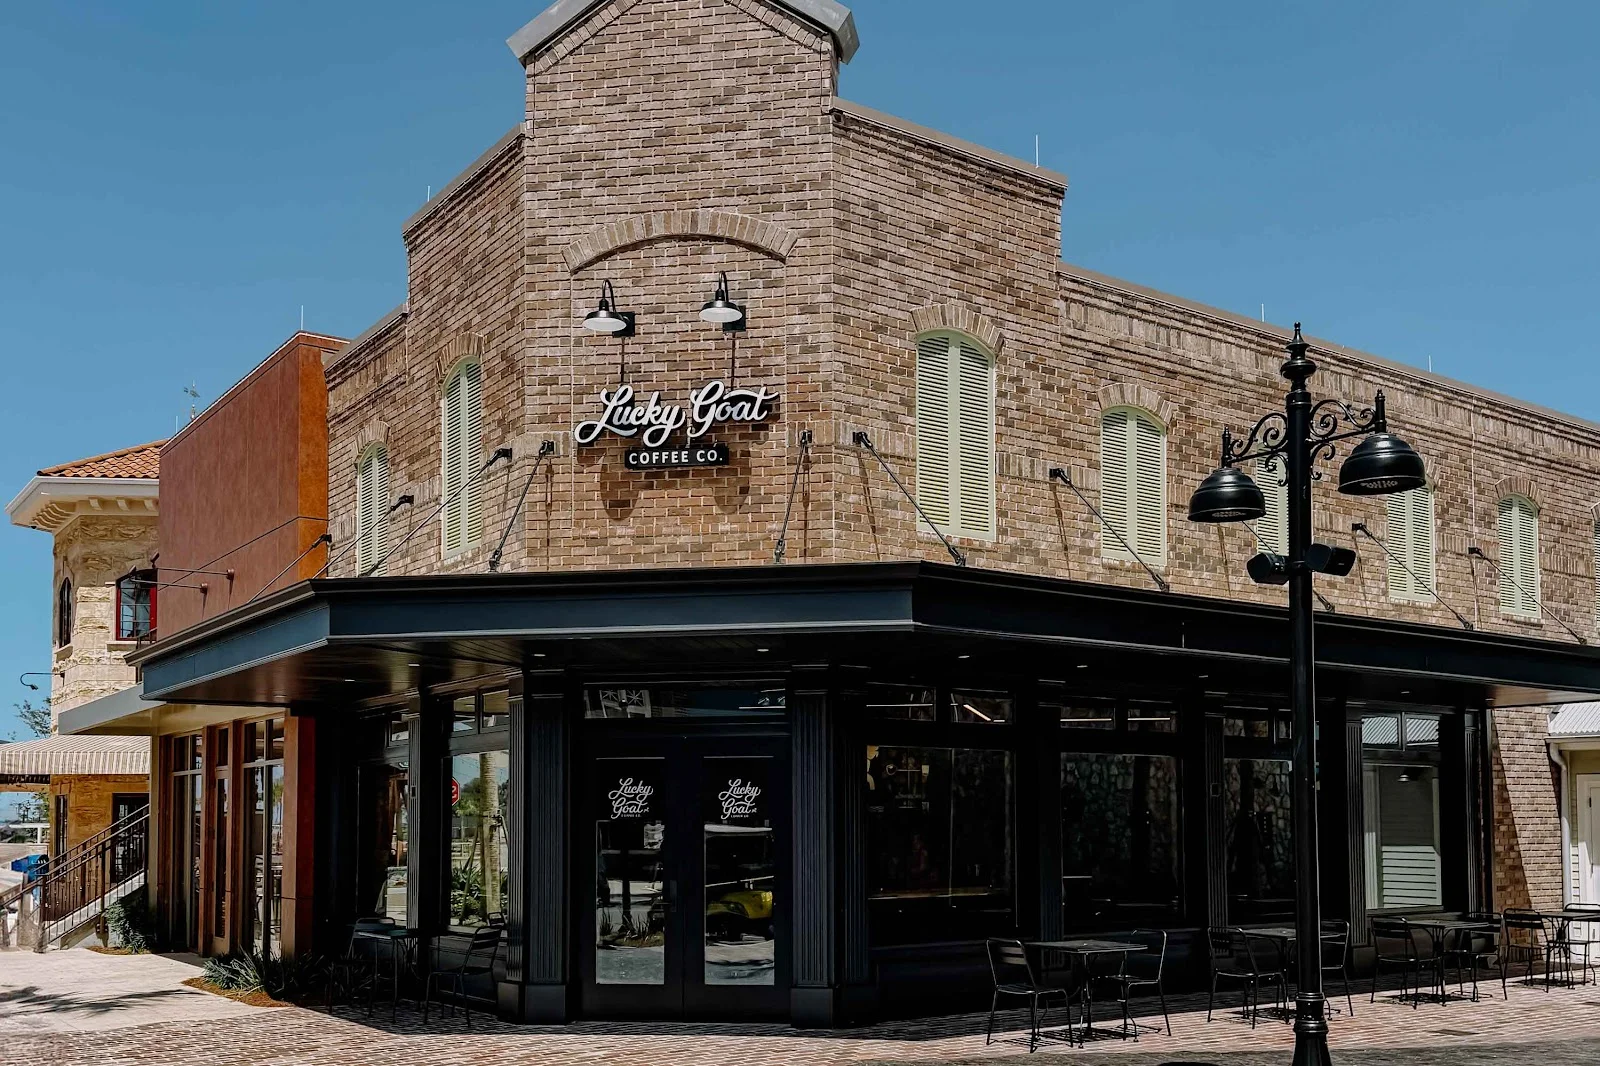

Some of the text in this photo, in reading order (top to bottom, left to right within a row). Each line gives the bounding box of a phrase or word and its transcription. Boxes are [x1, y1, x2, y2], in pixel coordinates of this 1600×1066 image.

[574, 380, 780, 447] Lucky Goat
[628, 449, 724, 465] COFFEE CO.
[608, 777, 654, 802] Lucky
[718, 778, 761, 803] Lucky
[610, 797, 648, 819] Goat
[720, 798, 756, 819] Goat
